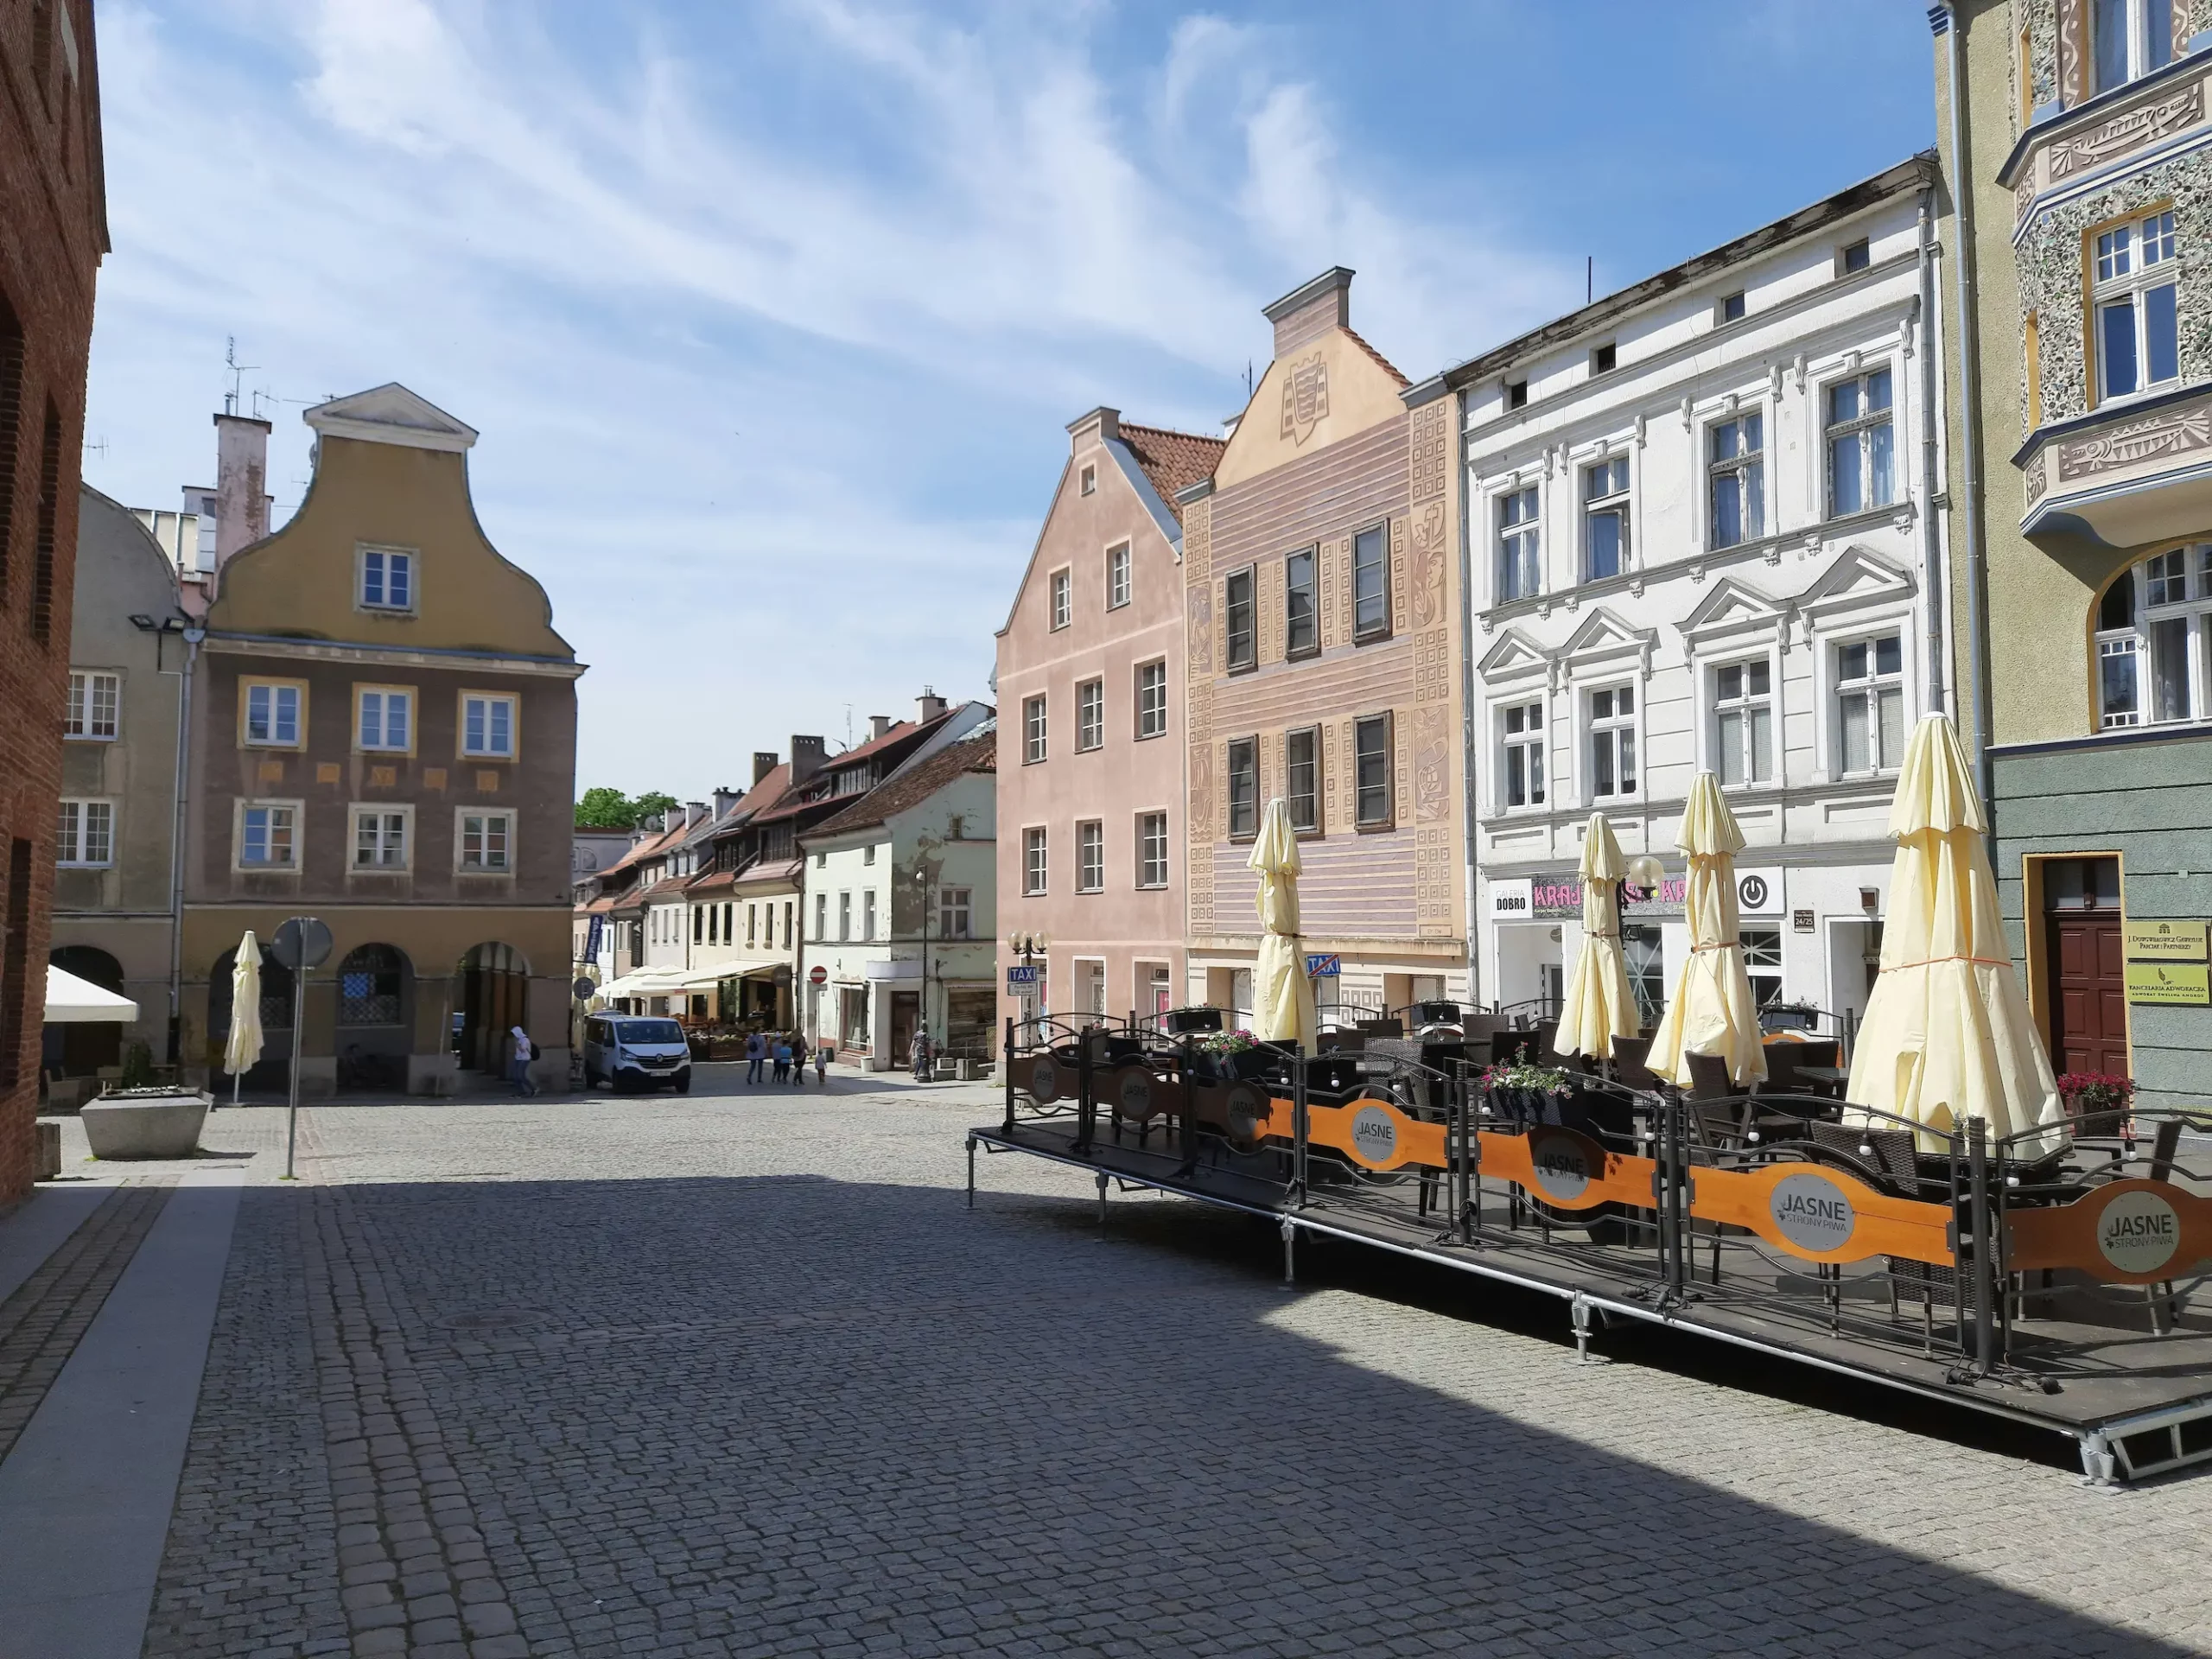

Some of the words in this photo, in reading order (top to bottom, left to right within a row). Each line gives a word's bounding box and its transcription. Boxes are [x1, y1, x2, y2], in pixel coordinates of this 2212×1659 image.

[1496, 889, 1525, 899] GALERIA
[1497, 898, 1526, 910] DOBRO
[588, 917, 600, 962] APTEKA
[1308, 957, 1339, 973] TAXI
[1011, 968, 1036, 981] TAXI
[1035, 1070, 1052, 1082] JASNE
[1125, 1084, 1147, 1097] JASNE
[1231, 1101, 1255, 1116] JASNE
[1358, 1122, 1392, 1140] JASNE
[1541, 1152, 1584, 1174] JASNE
[1782, 1194, 1846, 1221] JASNE
[1787, 1213, 1822, 1228] STRONY
[1823, 1219, 1847, 1232] PIWA
[2108, 1214, 2172, 1236] JASNE
[2115, 1236, 2150, 1248] STRONY
[2151, 1236, 2174, 1246] PIWA
